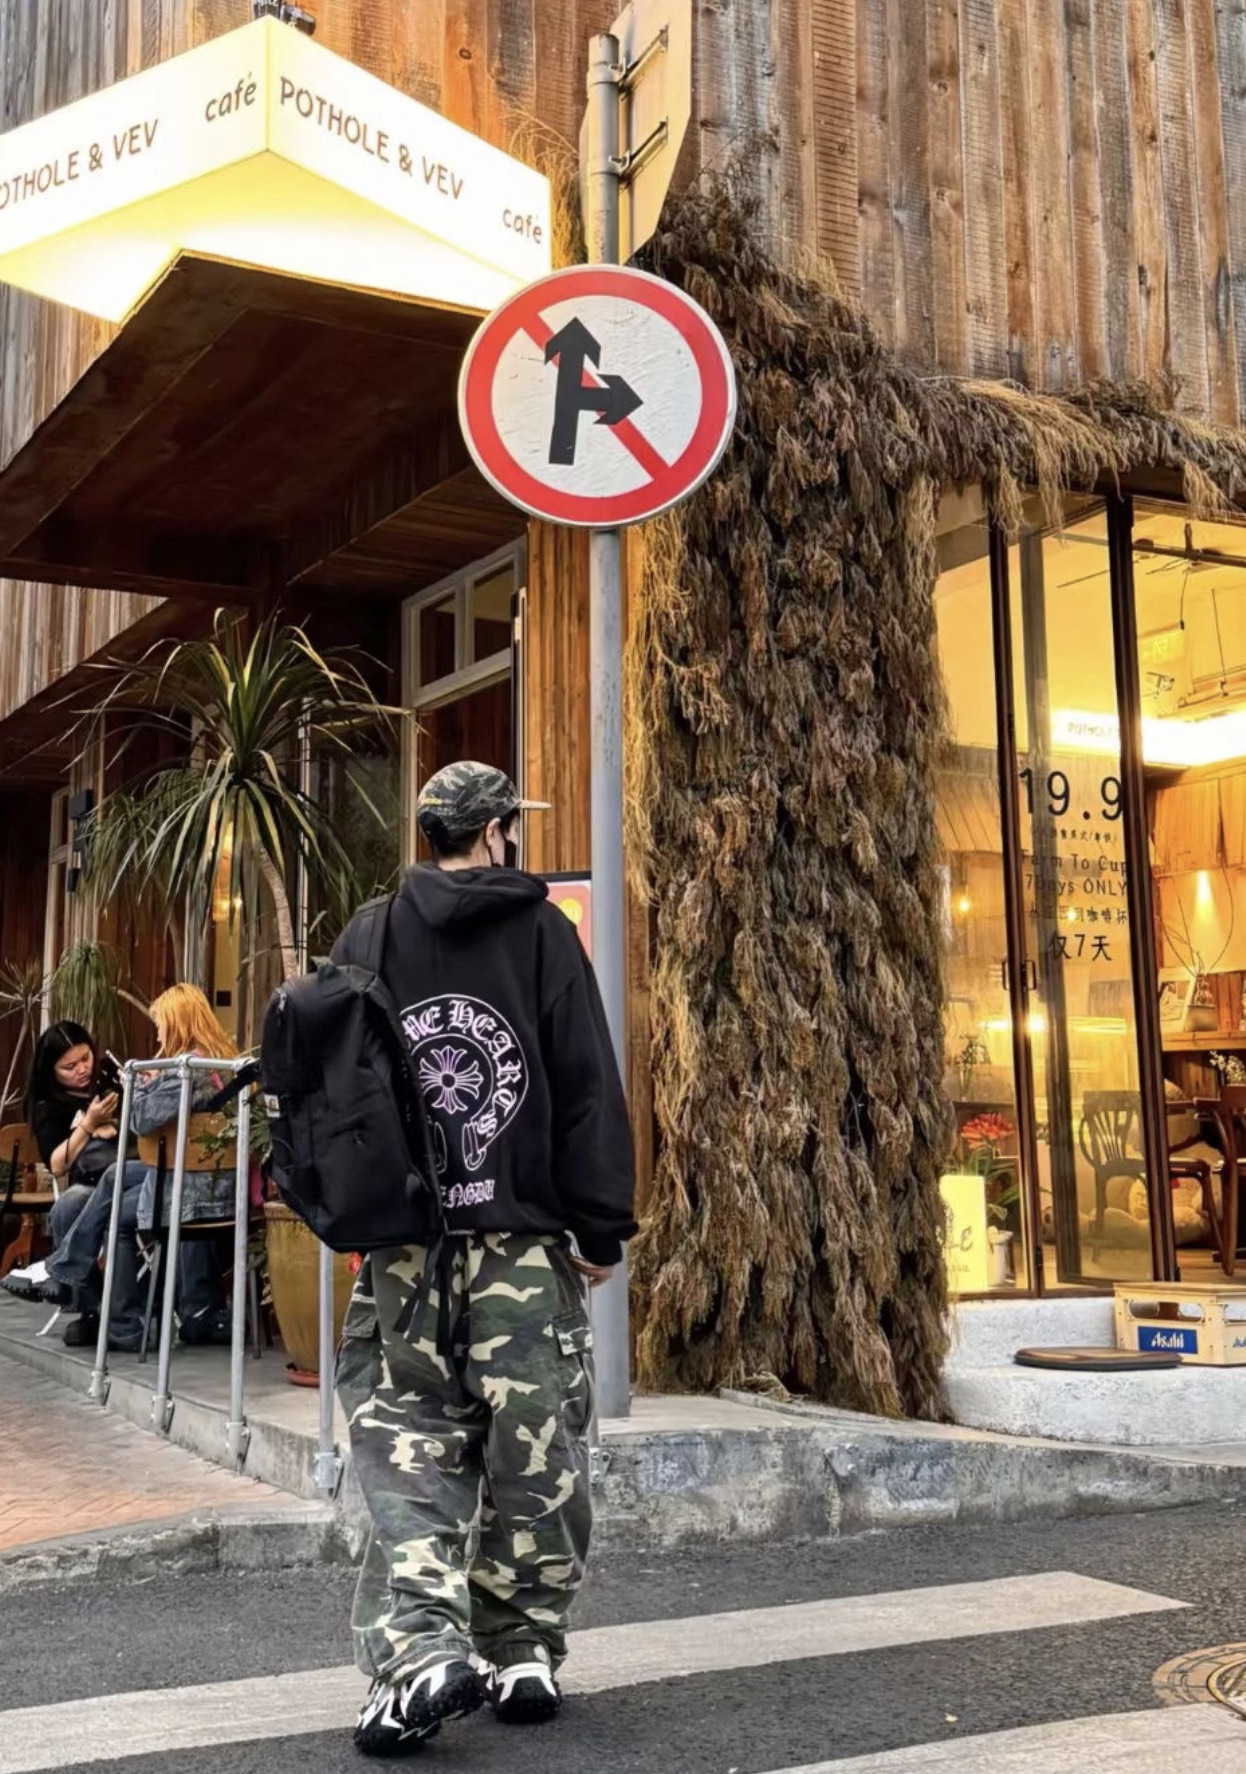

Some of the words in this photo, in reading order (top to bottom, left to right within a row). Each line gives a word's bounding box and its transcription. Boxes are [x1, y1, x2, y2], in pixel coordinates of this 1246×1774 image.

[205, 71, 257, 122] café
[88, 143, 103, 172] &
[113, 118, 159, 161] VEV
[279, 76, 390, 164] POTHOLE
[398, 144, 413, 177] &
[422, 156, 464, 200] VEV
[502, 207, 543, 244] café
[1019, 767, 1123, 821] 19.9
[1071, 853, 1090, 870] To
[1083, 878, 1127, 897] ONLY
[1151, 1331, 1185, 1348] Asahi
